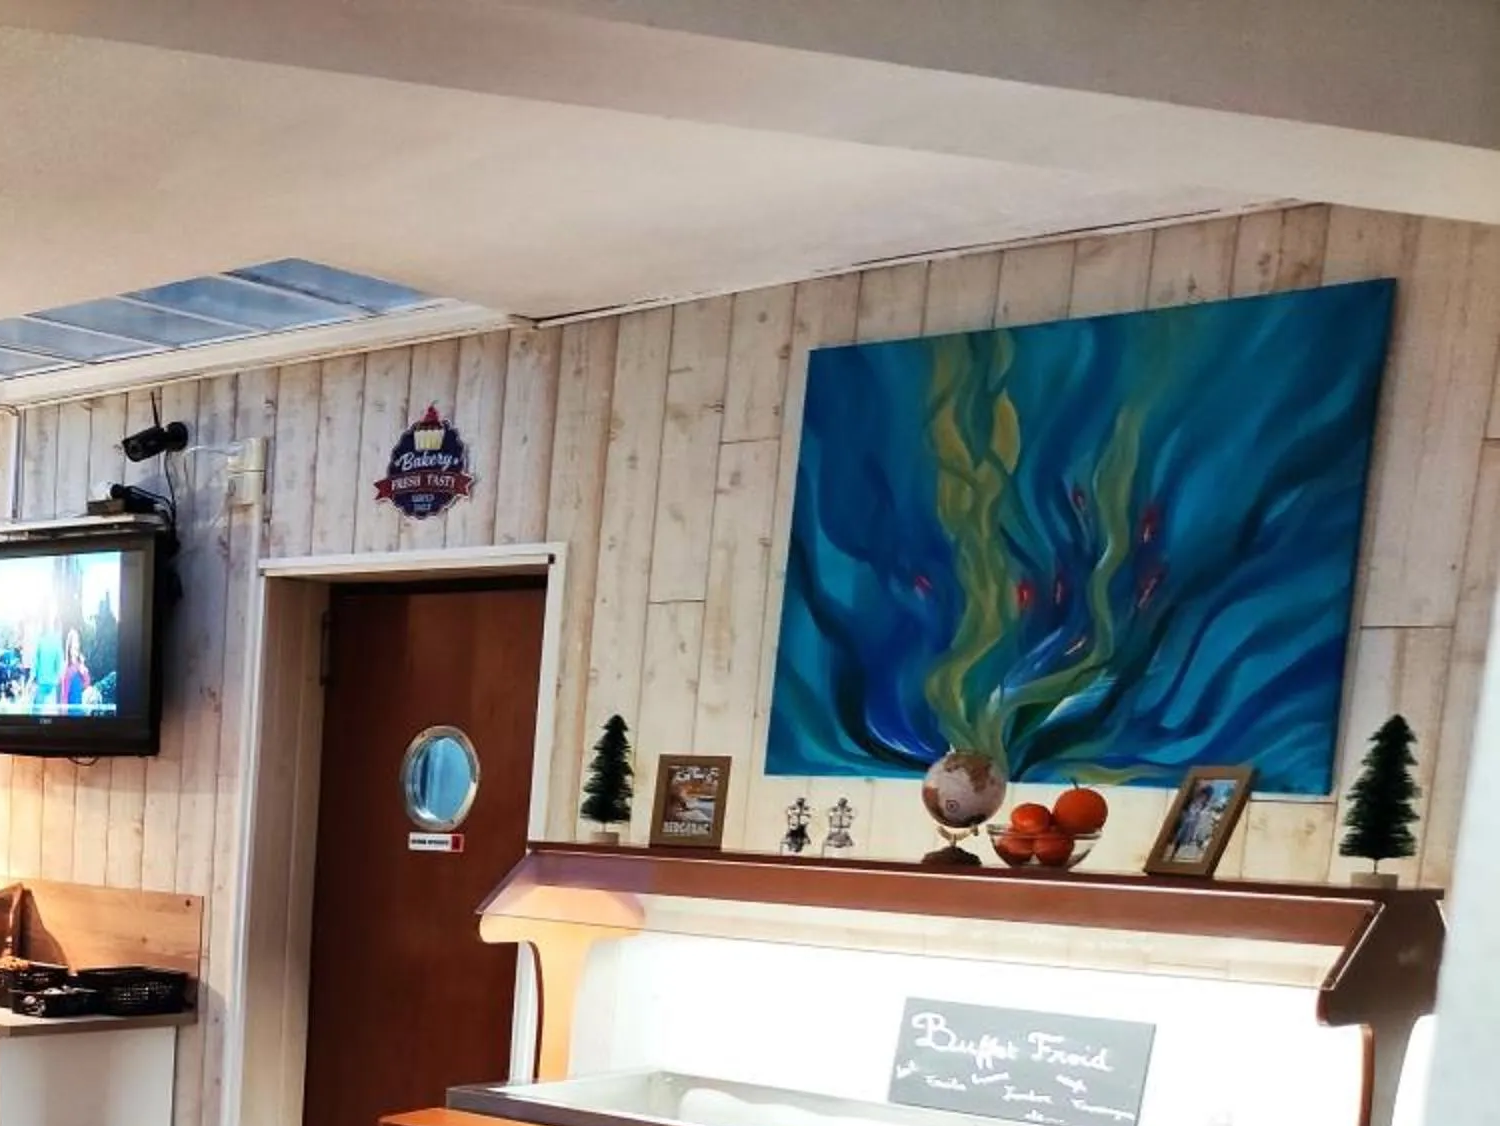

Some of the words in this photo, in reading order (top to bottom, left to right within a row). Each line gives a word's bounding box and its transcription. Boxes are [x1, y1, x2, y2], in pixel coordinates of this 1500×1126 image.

[397, 451, 453, 471] Bakery
[911, 1011, 1020, 1070] Buffet
[1027, 1031, 1114, 1073] Froid
